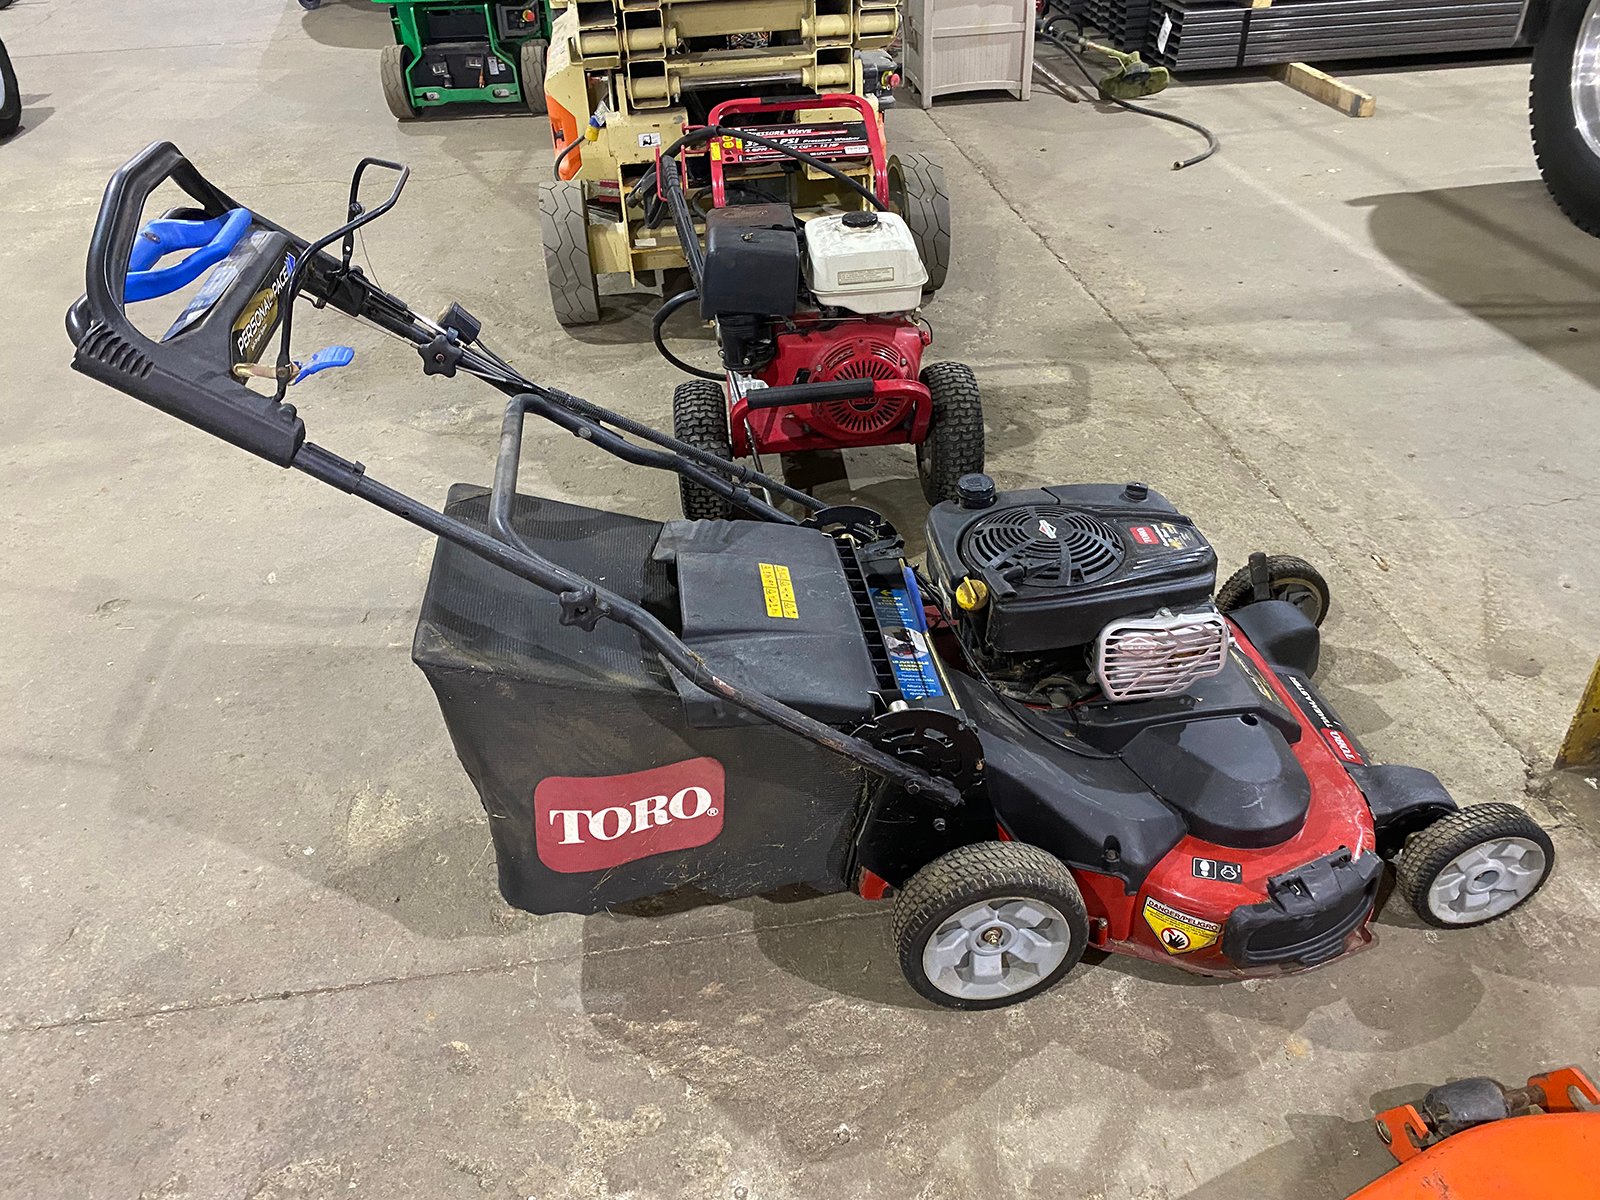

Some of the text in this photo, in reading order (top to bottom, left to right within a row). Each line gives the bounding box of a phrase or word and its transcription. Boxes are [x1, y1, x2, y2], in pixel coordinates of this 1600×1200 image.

[780, 137, 800, 145] PSI
[237, 293, 274, 356] PERSONAL
[271, 265, 289, 295] PACE
[1288, 675, 1333, 728] TIMEMASTER
[1329, 730, 1356, 760] TORO
[1148, 900, 1218, 931] DANGER/PELIGRO
